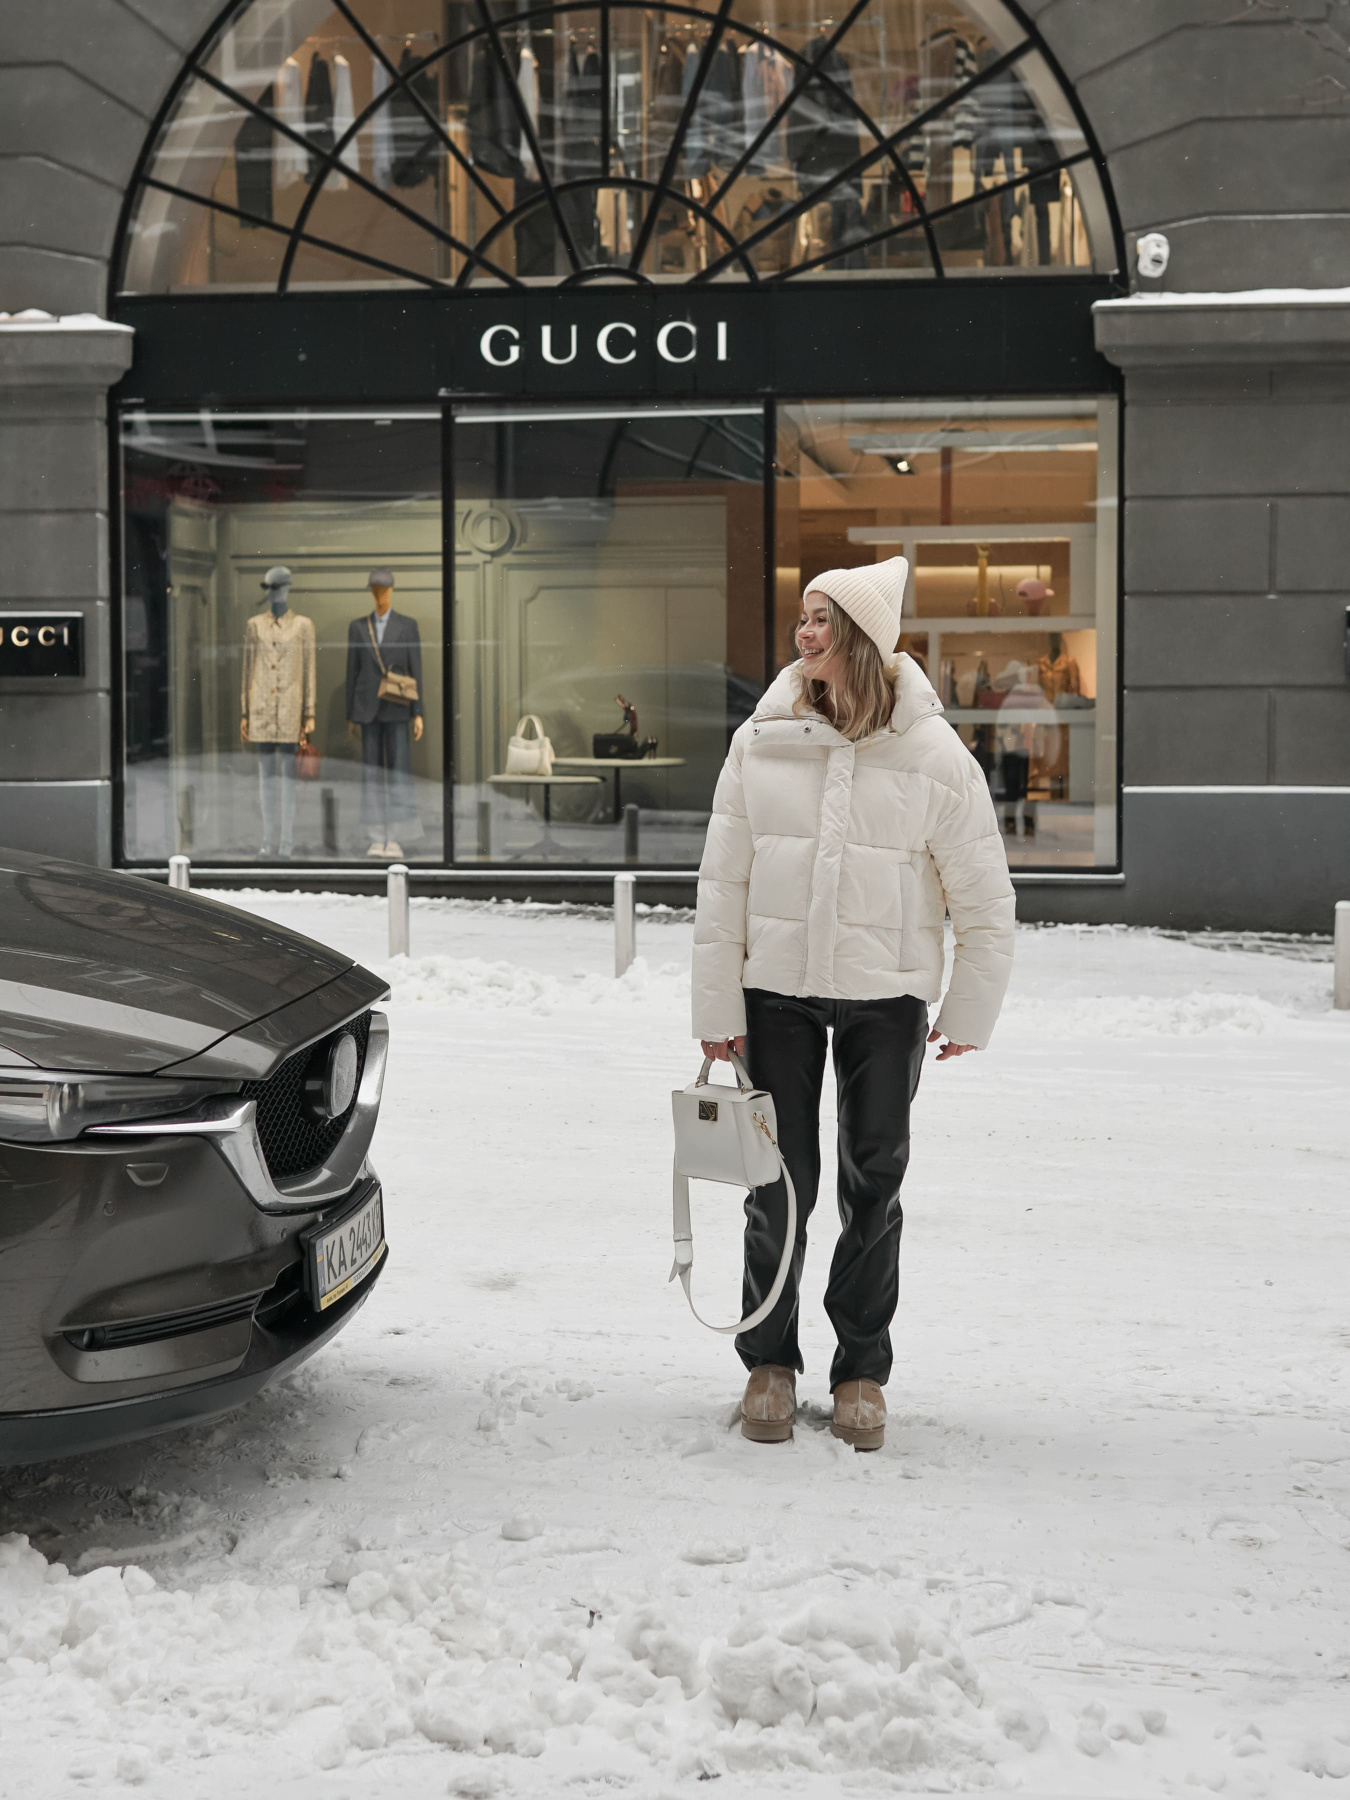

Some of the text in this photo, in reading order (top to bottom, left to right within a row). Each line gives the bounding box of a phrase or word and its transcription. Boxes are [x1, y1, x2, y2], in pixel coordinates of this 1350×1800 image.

[480, 321, 727, 366] GUCCI
[0, 625, 69, 647] CCI
[326, 1236, 348, 1284] KA
[349, 1212, 372, 1268] 2443
